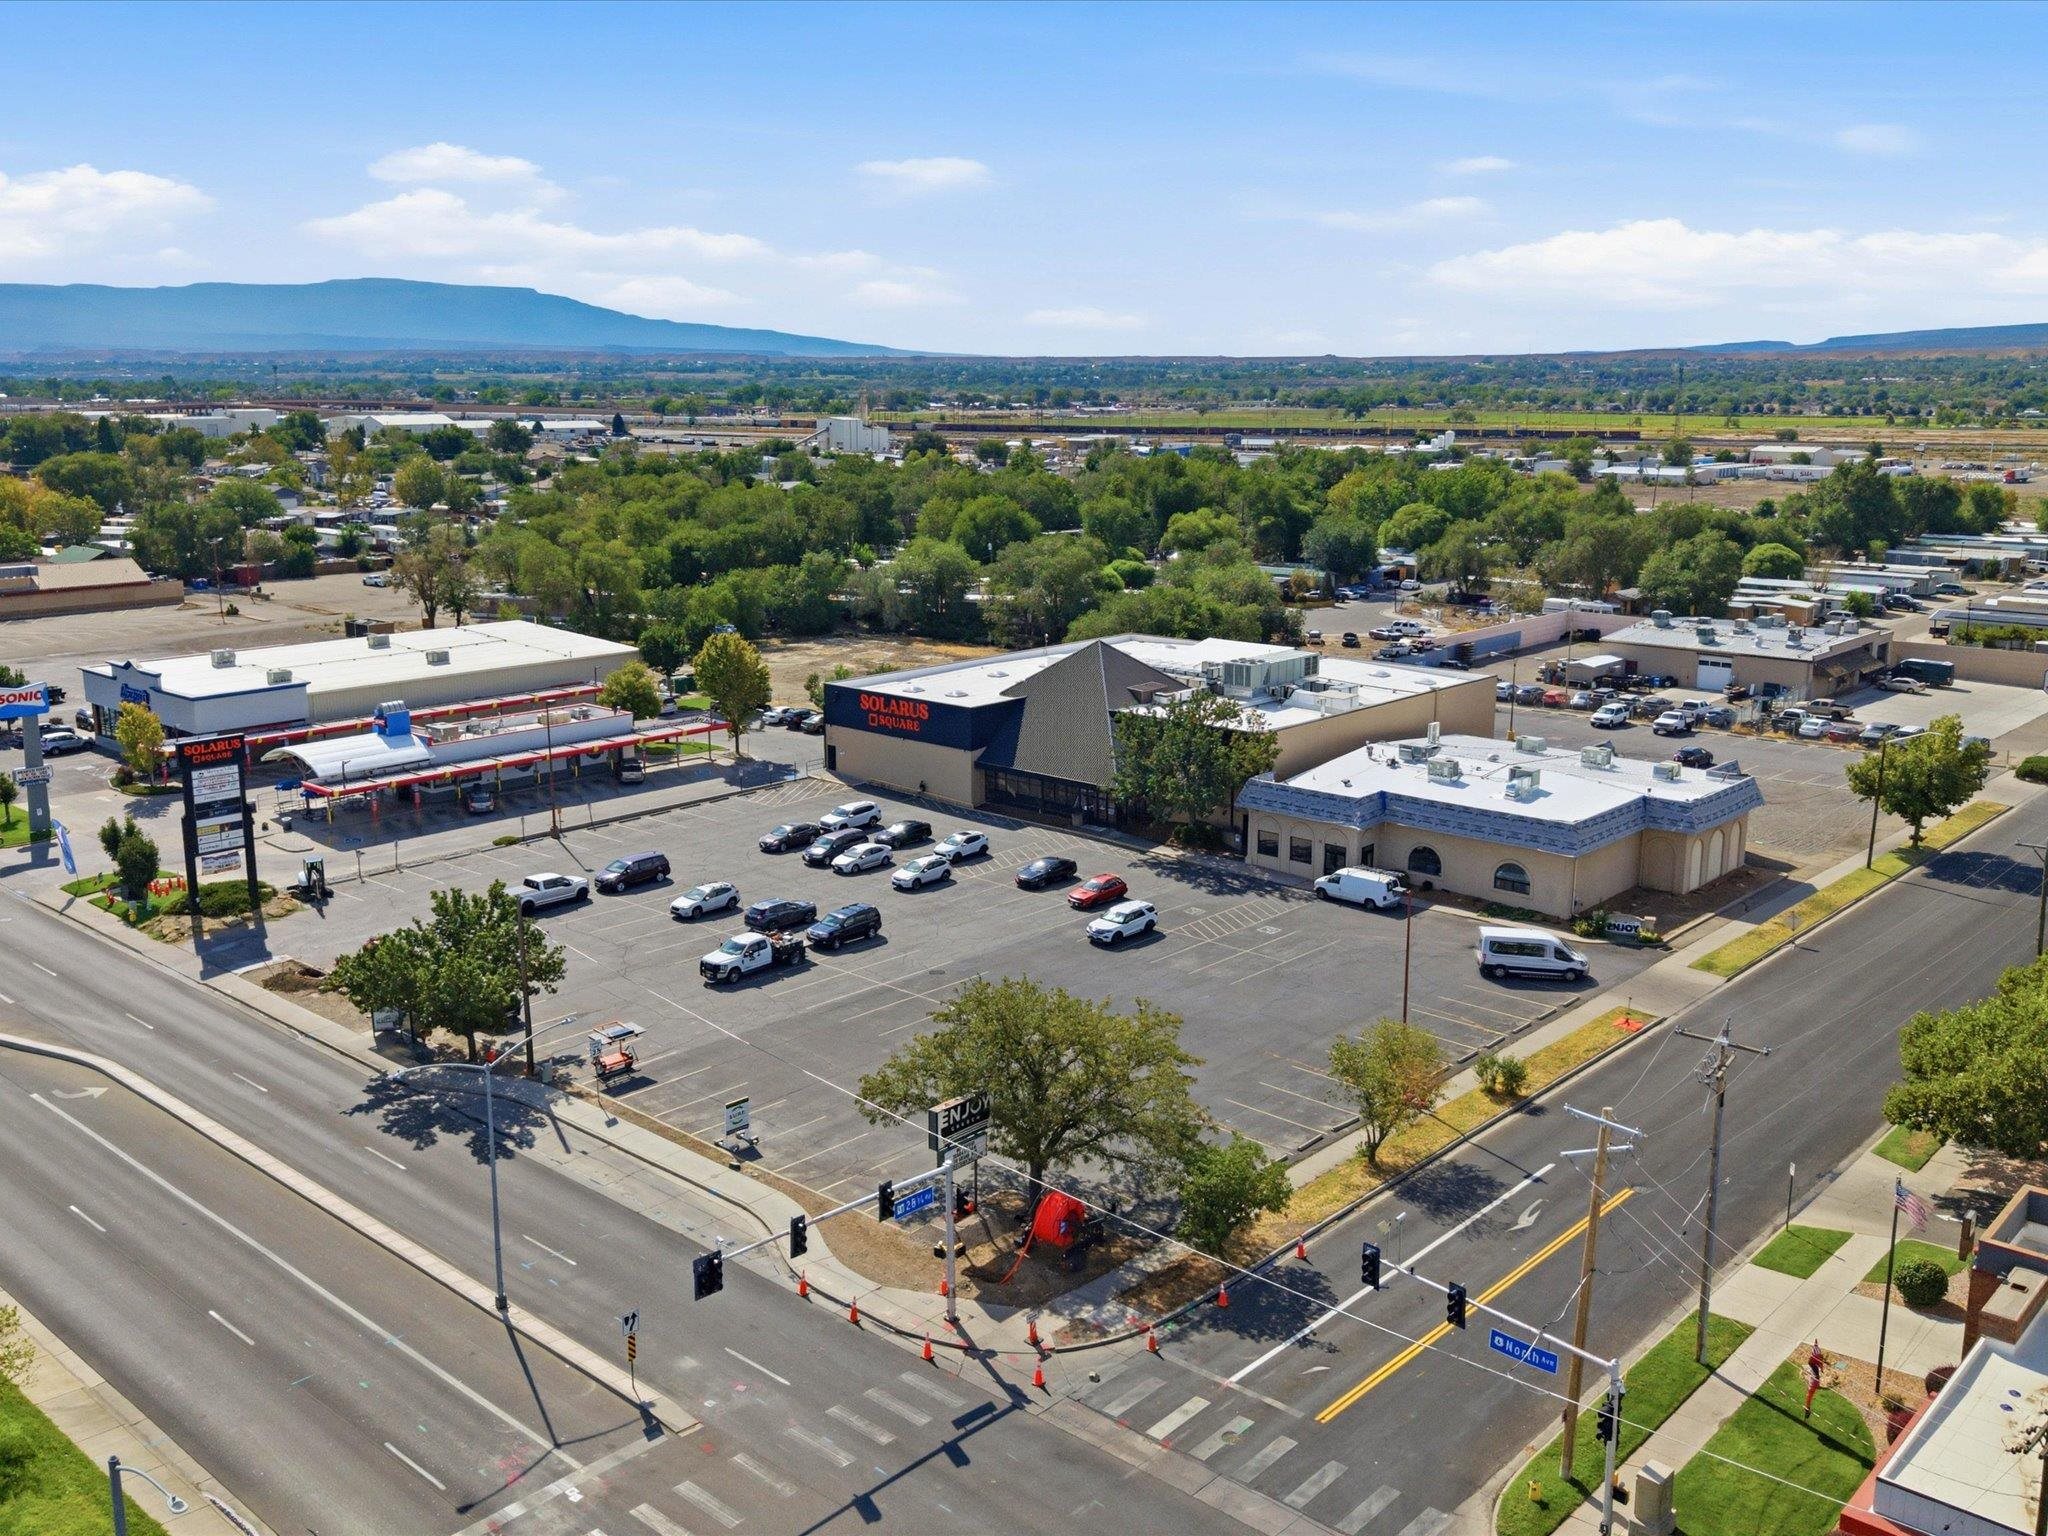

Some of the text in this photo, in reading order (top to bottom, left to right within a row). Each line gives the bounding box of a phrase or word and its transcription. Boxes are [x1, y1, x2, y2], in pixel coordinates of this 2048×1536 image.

[860, 693, 929, 720] SOLARUS
[879, 717, 920, 732] SQUARE
[184, 738, 241, 756] SOLARUS
[1606, 922, 1640, 933] ENJOY
[938, 1096, 990, 1130] ENJOY
[1506, 1340, 1555, 1367] North Ave
